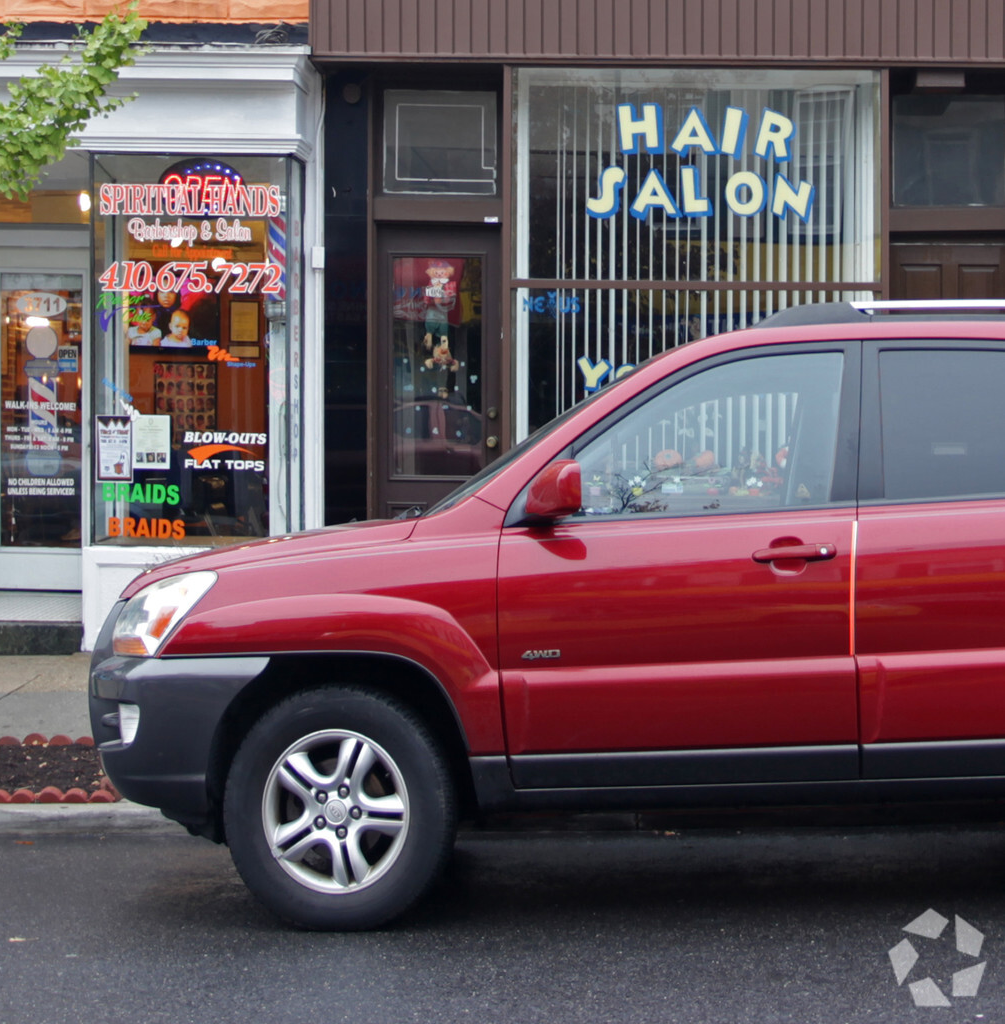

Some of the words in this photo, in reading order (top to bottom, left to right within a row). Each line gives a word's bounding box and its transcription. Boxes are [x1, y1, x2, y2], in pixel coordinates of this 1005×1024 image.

[616, 102, 797, 163] HAIR
[165, 174, 241, 204] OPEN
[586, 165, 816, 224] SALON
[99, 183, 205, 216] SPIRITUAL
[207, 185, 281, 217] HANDS
[128, 217, 198, 247] Barbershop
[200, 220, 212, 241] &
[215, 218, 252, 242] Salon
[99, 260, 283, 295] 410.675.7272
[25, 297, 60, 312] 3711
[190, 338, 218, 346] Barber
[58, 349, 77, 359] OPEN
[5, 401, 39, 410] WALK-INS
[184, 432, 267, 444] BLOW-OUTS
[184, 459, 221, 469] FLAT
[225, 460, 265, 472] TOPS
[8, 478, 16, 486] NO
[18, 478, 46, 486] CHILDREN
[47, 478, 74, 486] ALLOWED
[7, 487, 28, 495] UNLESS
[102, 482, 181, 505] BRAIDS
[108, 516, 186, 541] BRAIDS
[521, 649, 561, 660] 4WD
